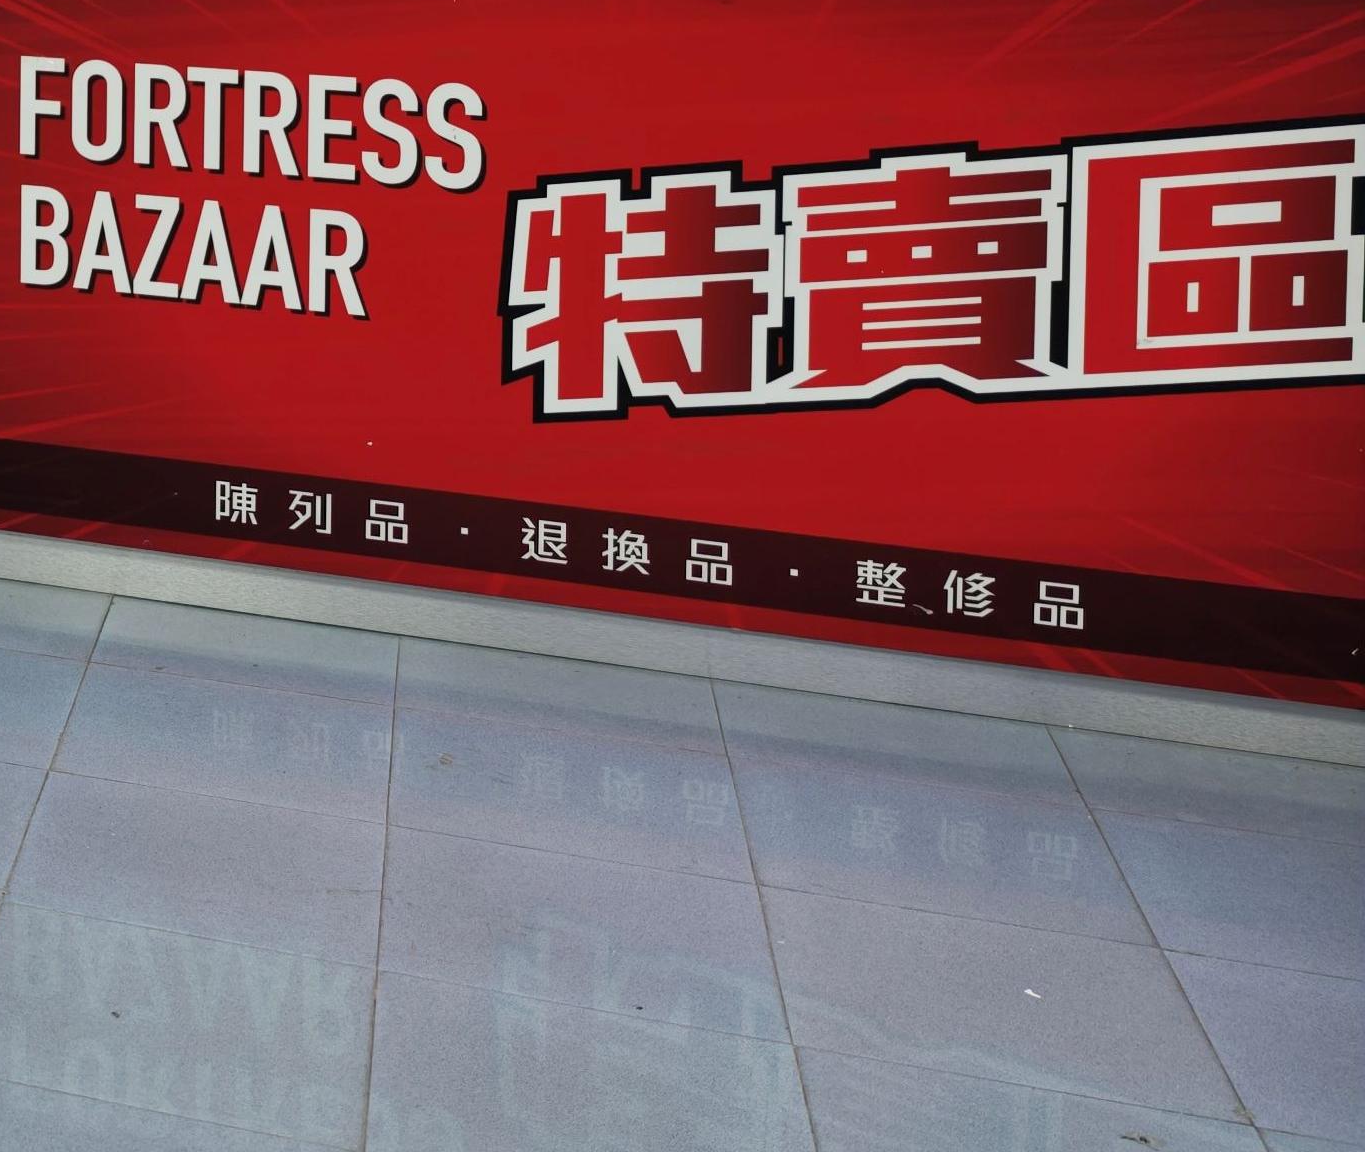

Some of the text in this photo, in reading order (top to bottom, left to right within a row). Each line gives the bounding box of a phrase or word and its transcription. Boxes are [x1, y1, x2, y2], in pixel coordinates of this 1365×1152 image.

[19, 56, 487, 192] FORTRESS
[19, 185, 371, 319] BAZAAR
[507, 126, 1365, 415] 特賣區
[213, 479, 1089, 632] 陳列品 退換品 整修品
